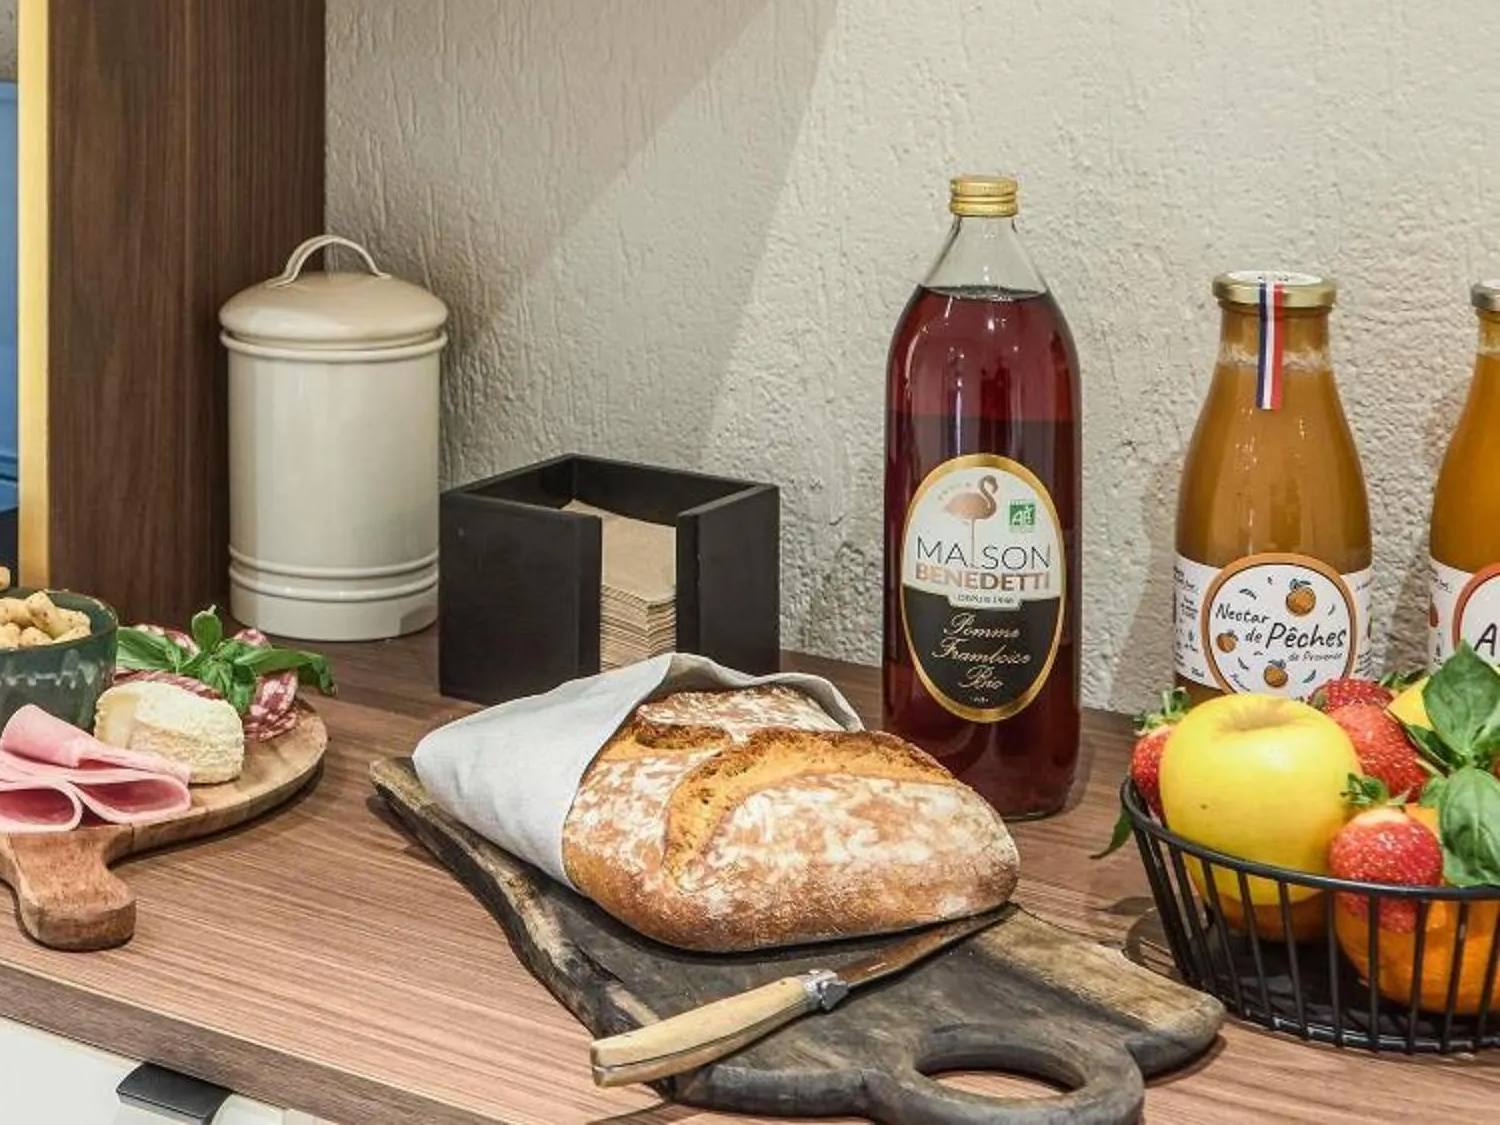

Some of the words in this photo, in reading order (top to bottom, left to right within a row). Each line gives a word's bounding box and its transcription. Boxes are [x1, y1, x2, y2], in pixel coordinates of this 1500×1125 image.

[916, 535, 1051, 570] MAISON
[915, 562, 1050, 591] BENEDETTI
[1215, 603, 1270, 624] Nectar
[1245, 628, 1263, 644] de
[1265, 622, 1347, 649] Pêches
